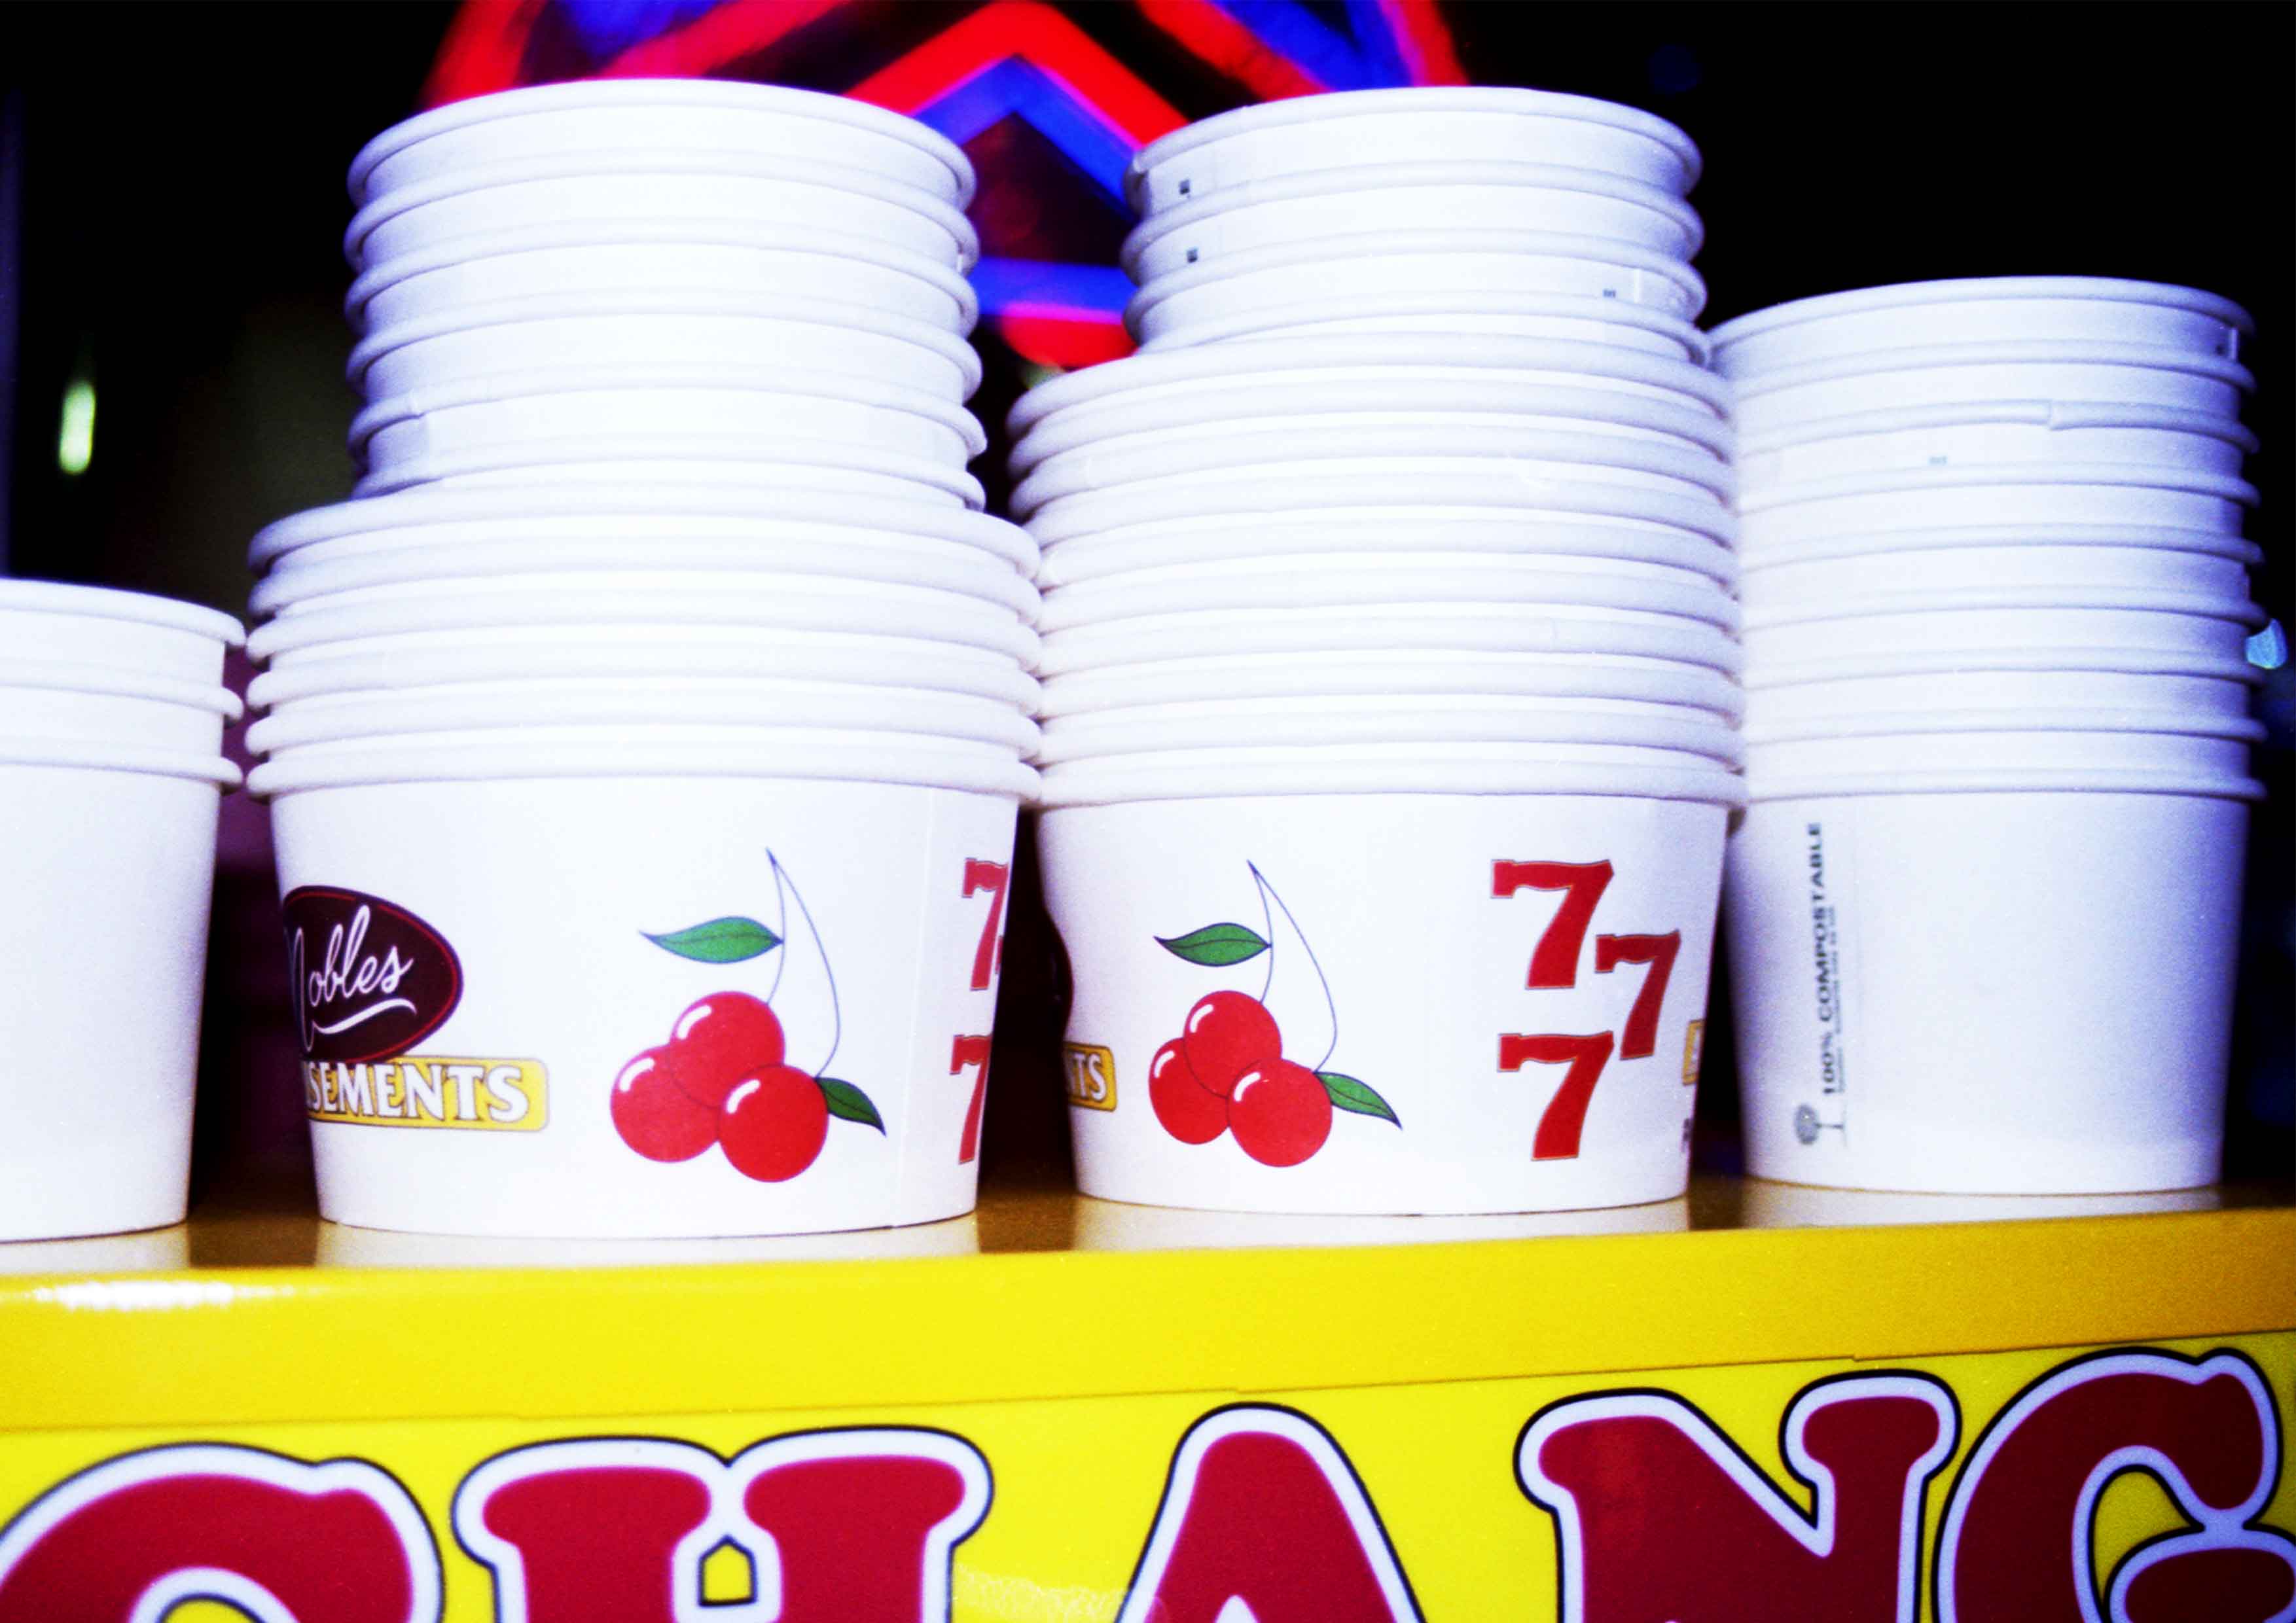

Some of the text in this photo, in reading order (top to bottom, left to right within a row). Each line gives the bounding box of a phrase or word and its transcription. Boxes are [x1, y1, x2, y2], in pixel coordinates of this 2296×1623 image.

[1490, 859, 1614, 990] 7
[1808, 823, 1833, 1022] COMPOSTABLE
[1595, 929, 1681, 1061] 7
[304, 1061, 529, 1122] SEMENTS
[1498, 1030, 1614, 1161] 7
